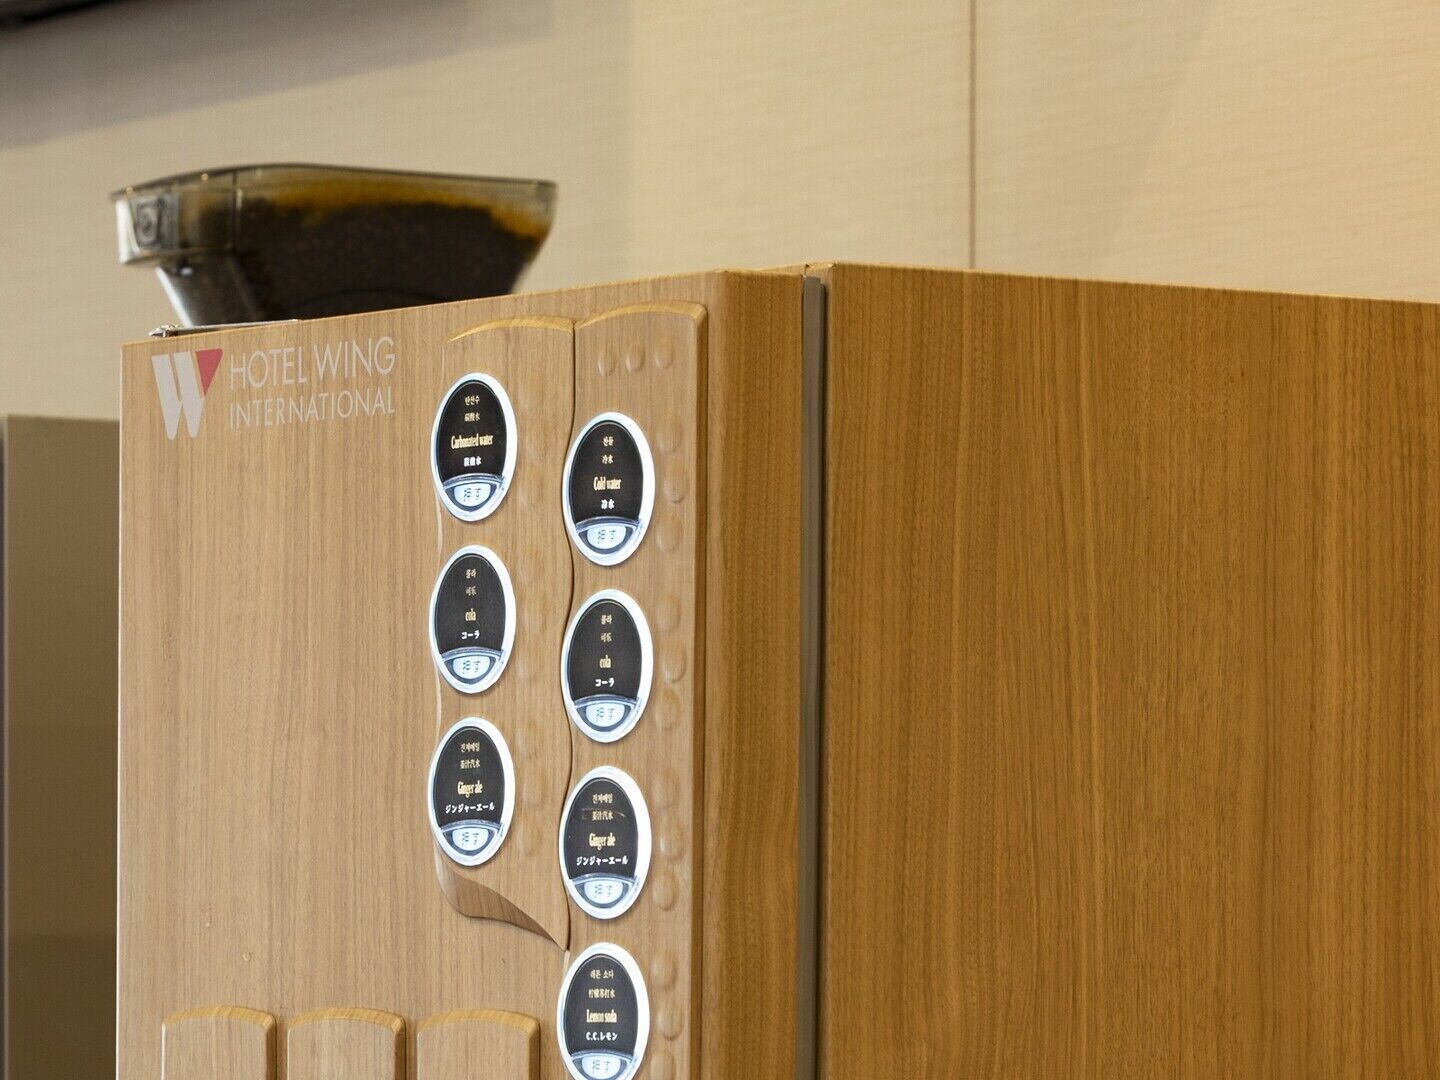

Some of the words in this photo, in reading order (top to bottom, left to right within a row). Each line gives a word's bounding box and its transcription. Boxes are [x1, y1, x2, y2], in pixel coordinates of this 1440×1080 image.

[230, 347, 307, 390] HOTEL
[314, 336, 396, 380] WING
[230, 386, 395, 430] INTERNATIONAL
[451, 433, 478, 449] Carbonated
[480, 435, 493, 446] water
[594, 477, 606, 490] Cold
[607, 479, 622, 490] water
[465, 608, 476, 621] cola
[462, 630, 480, 640] コーラ
[600, 655, 611, 668] cola
[595, 678, 614, 687] コーラ
[458, 781, 474, 798] Ginger
[474, 780, 482, 793] ale
[446, 802, 495, 814] ジンジャーエール
[589, 833, 606, 850] Ginger
[607, 832, 616, 846] ale
[577, 856, 628, 866] ジンジャーエール
[586, 1009, 604, 1023] Lemon
[604, 1009, 617, 1023] soda
[586, 1032, 618, 1041] C.C.レモン
